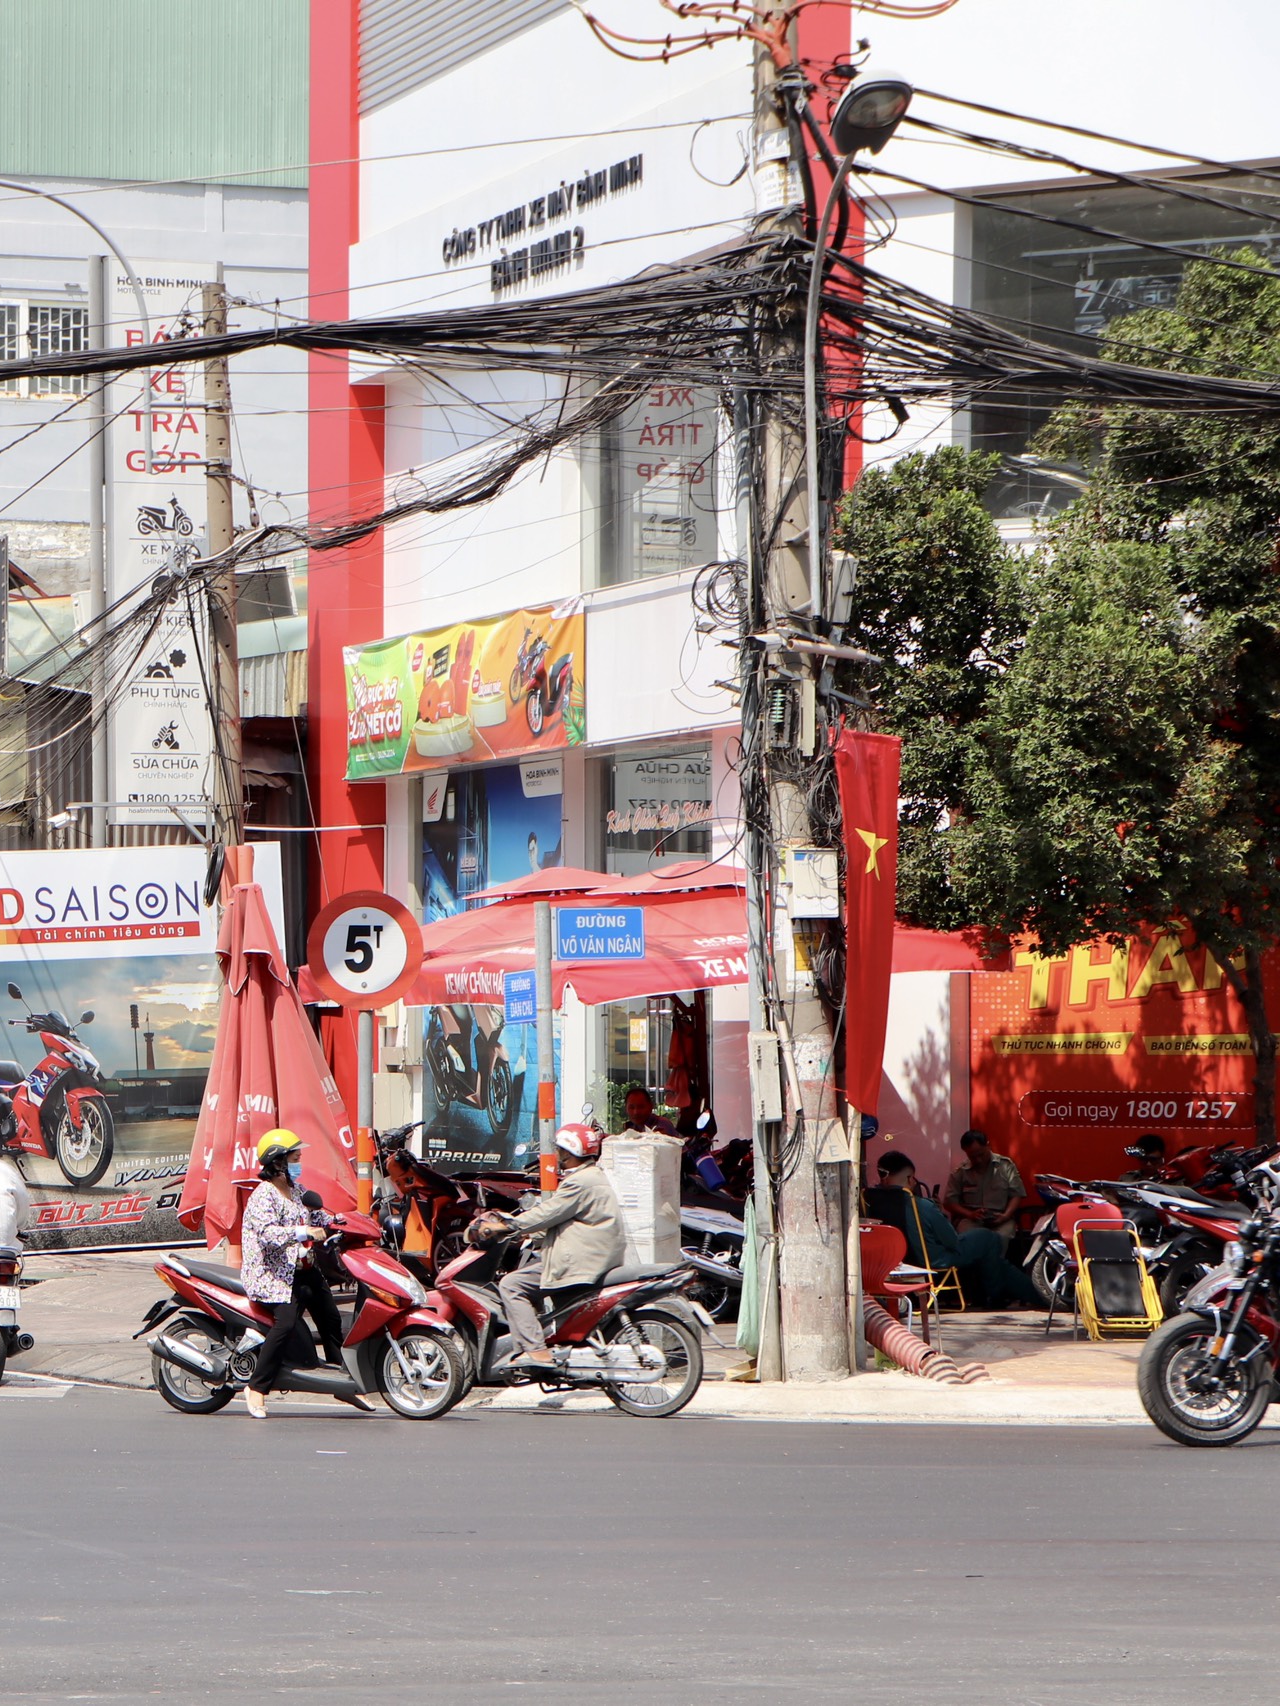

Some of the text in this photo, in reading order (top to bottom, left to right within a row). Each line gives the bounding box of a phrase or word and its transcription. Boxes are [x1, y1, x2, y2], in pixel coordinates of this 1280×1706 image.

[442, 227, 476, 263] CÔNG
[477, 220, 494, 248] TY
[528, 197, 545, 227] XE
[610, 153, 643, 192] MINH
[573, 226, 584, 260] 2
[117, 287, 162, 295] MOTOCYCLE
[141, 545, 157, 554] XE
[133, 756, 199, 769] SỬA CHỮA
[35, 880, 200, 924] SAISON
[576, 913, 626, 929] ĐƯỜNG
[36, 924, 185, 940] Tài chính tiêu dùng
[562, 934, 641, 954] VÕ VĂN NGÂN
[511, 976, 531, 992] ĐƯỜNG
[1001, 1037, 1121, 1052] THỦ TỤC NHANH CHÓNG
[1150, 1041, 1175, 1051] BAO
[1201, 1037, 1217, 1051] SỐ
[1219, 1038, 1247, 1051] TOÀN
[1044, 1100, 1237, 1122] Gọi ngay 1800 1257
[20, 1142, 42, 1150] HONDA
[116, 1153, 190, 1169] LIMITED EDITION
[428, 1150, 483, 1163] VARIO
[114, 1163, 190, 1187] WINNE
[100, 1191, 152, 1219] TỐC
